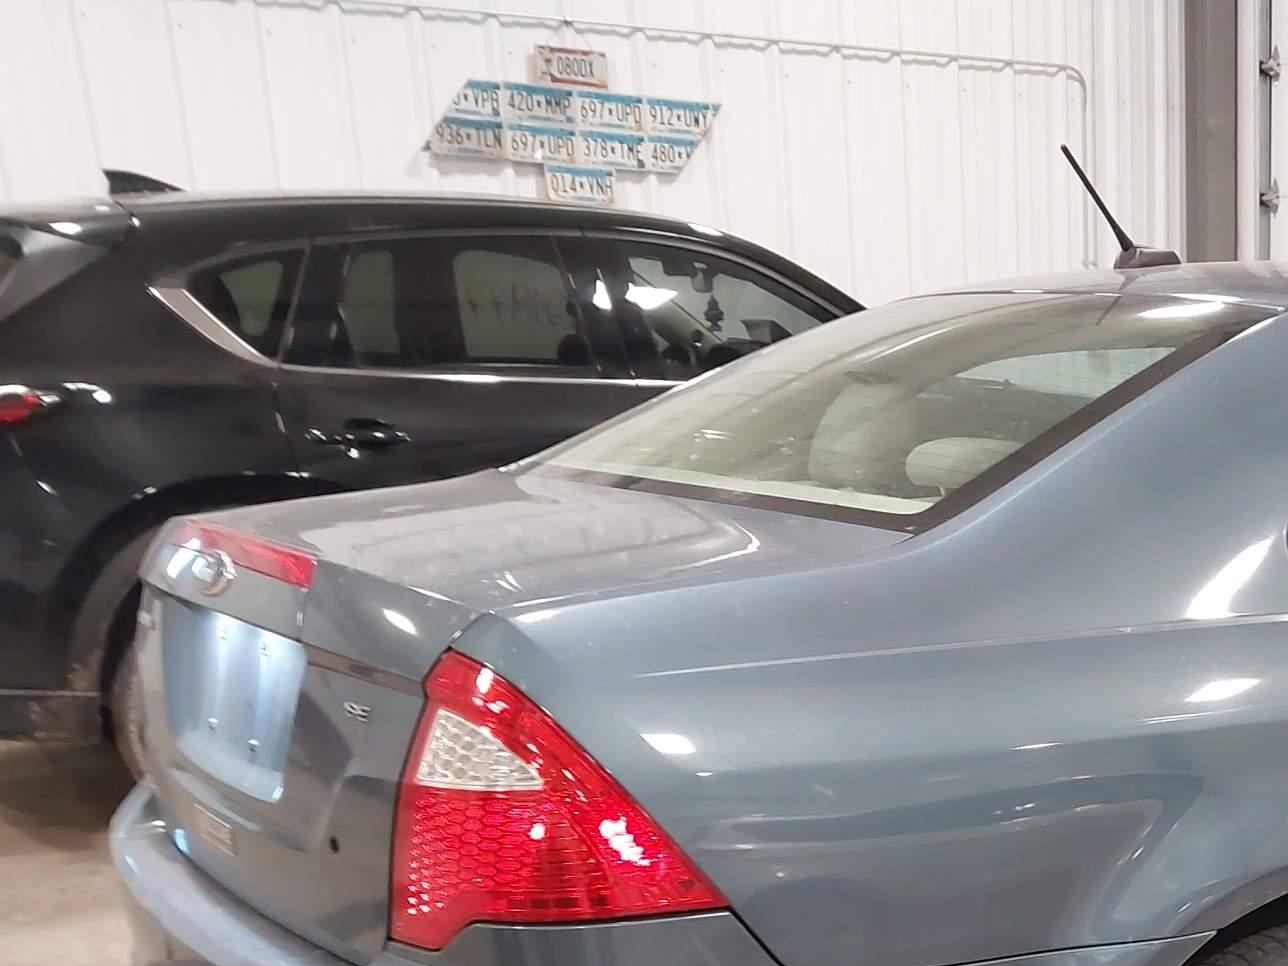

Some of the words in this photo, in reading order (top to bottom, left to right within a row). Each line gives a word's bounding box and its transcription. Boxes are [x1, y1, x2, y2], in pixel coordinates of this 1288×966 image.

[508, 92, 533, 112] 420
[581, 100, 605, 120] 697
[649, 106, 674, 126] 912
[435, 124, 464, 145] 936
[511, 133, 537, 152] 697
[583, 138, 609, 158] 378
[651, 144, 676, 163] 480
[343, 701, 371, 722] SE
